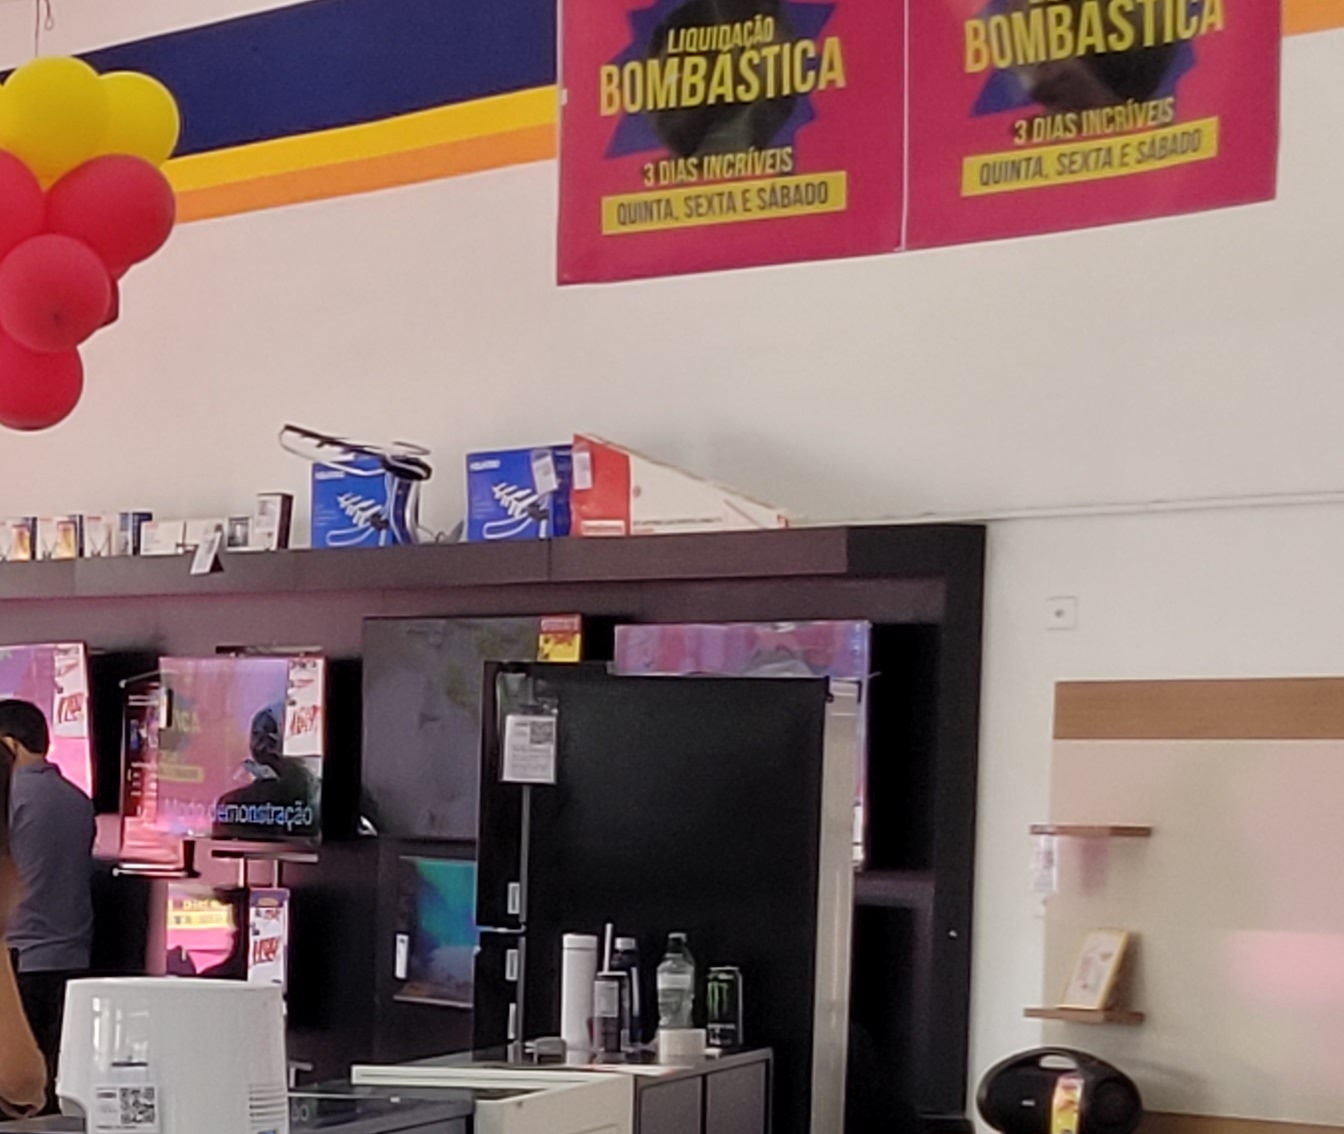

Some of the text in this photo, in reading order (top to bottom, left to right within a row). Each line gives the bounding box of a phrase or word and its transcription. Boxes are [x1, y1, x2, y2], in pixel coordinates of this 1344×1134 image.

[668, 14, 774, 53] LIQUIDAÇÃO
[1014, 97, 1174, 145] 3 DIAS INCRÍVEIS
[644, 147, 792, 187] 3 DIAS INCRÍVEIS
[980, 128, 1202, 186] QUINTA, SEXTA E SÁBADO
[617, 180, 828, 226] QUINTA, SEXTA E SÁBADO
